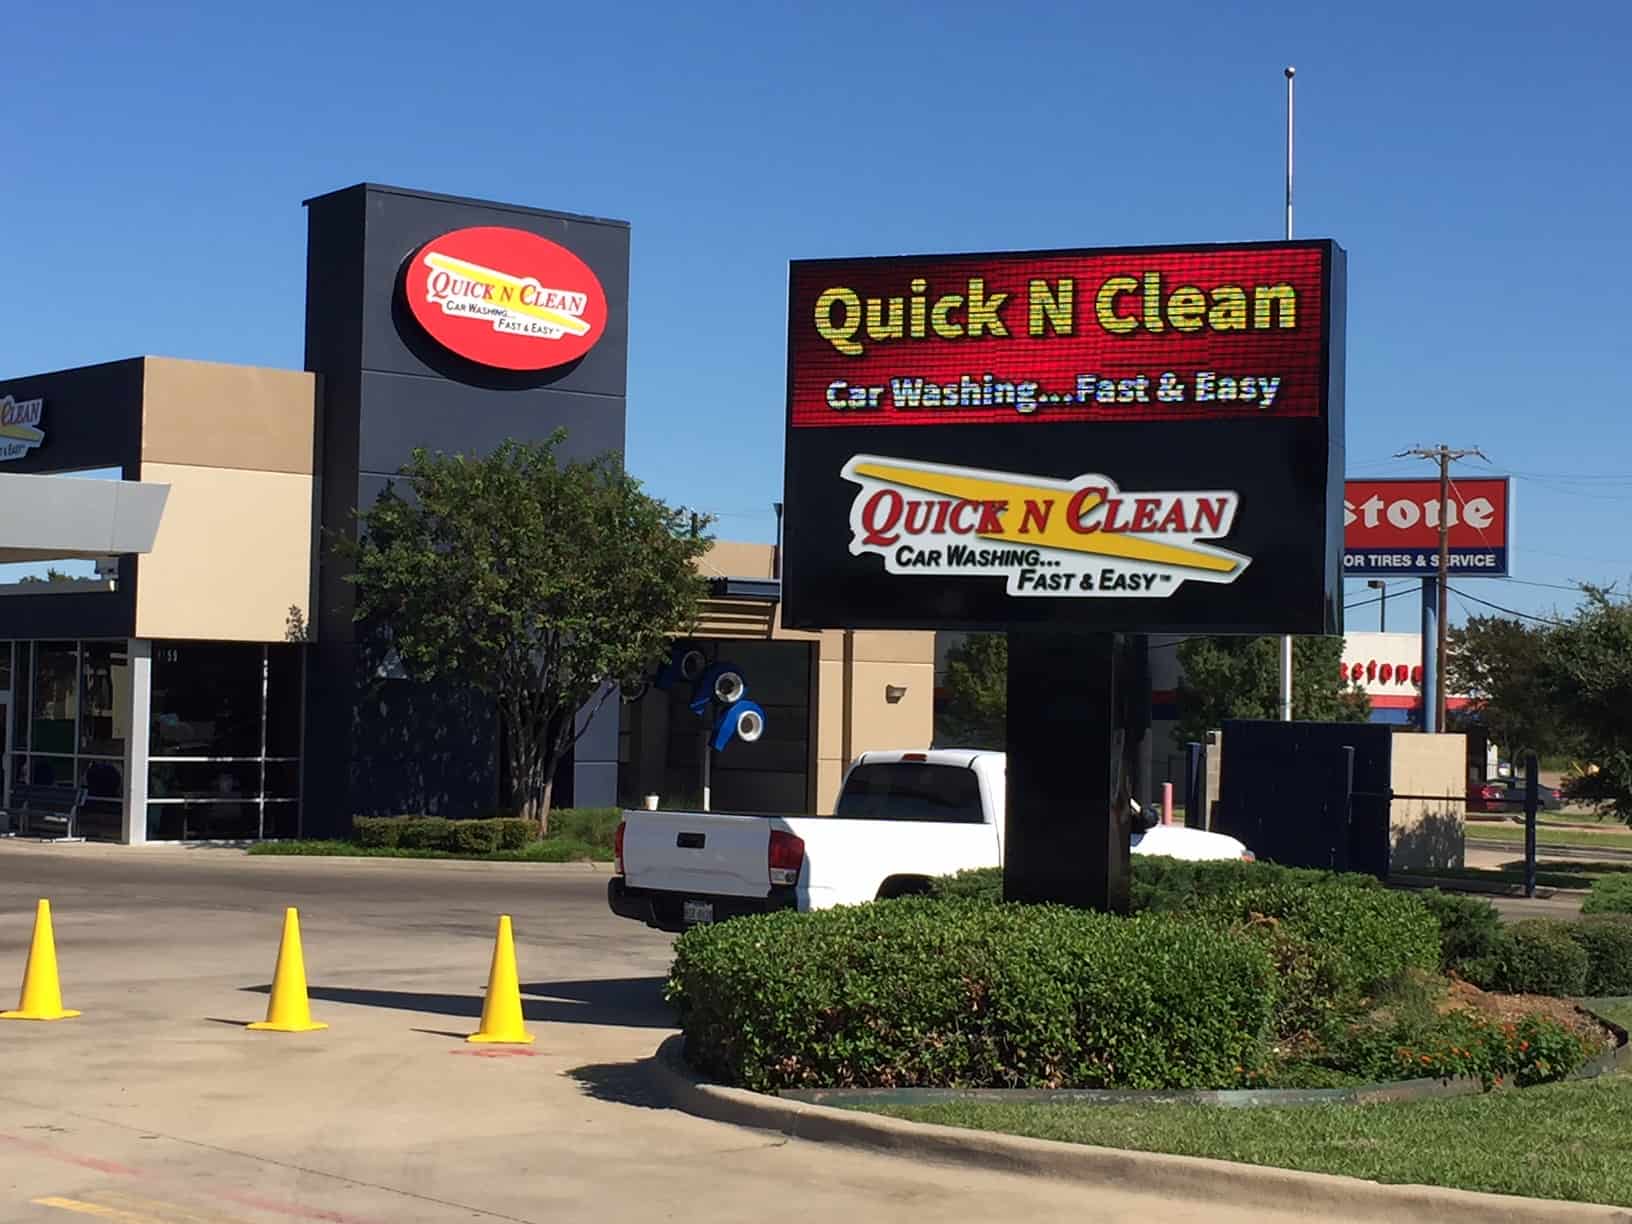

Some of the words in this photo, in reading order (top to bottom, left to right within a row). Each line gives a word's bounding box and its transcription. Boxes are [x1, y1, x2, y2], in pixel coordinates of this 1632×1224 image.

[432, 272, 495, 299] QUICK
[500, 286, 514, 303] N
[519, 284, 583, 312] CLEAN
[446, 300, 465, 311] CAR
[814, 277, 1008, 355] Quick
[1028, 278, 1074, 336] N
[1096, 271, 1296, 333] Clean
[498, 318, 521, 331] FAST
[826, 379, 884, 408] Car
[1157, 372, 1184, 402] &
[1195, 371, 1281, 408] Easy
[862, 488, 1008, 546] QUICK
[1018, 499, 1055, 534] N
[1066, 486, 1229, 534] CLEAN
[896, 545, 942, 567] CAR
[1368, 554, 1412, 567] TIRES
[1415, 554, 1427, 567] &
[1430, 554, 1496, 567] SRVICE
[1017, 569, 1076, 591] FAST
[1079, 573, 1093, 591] &
